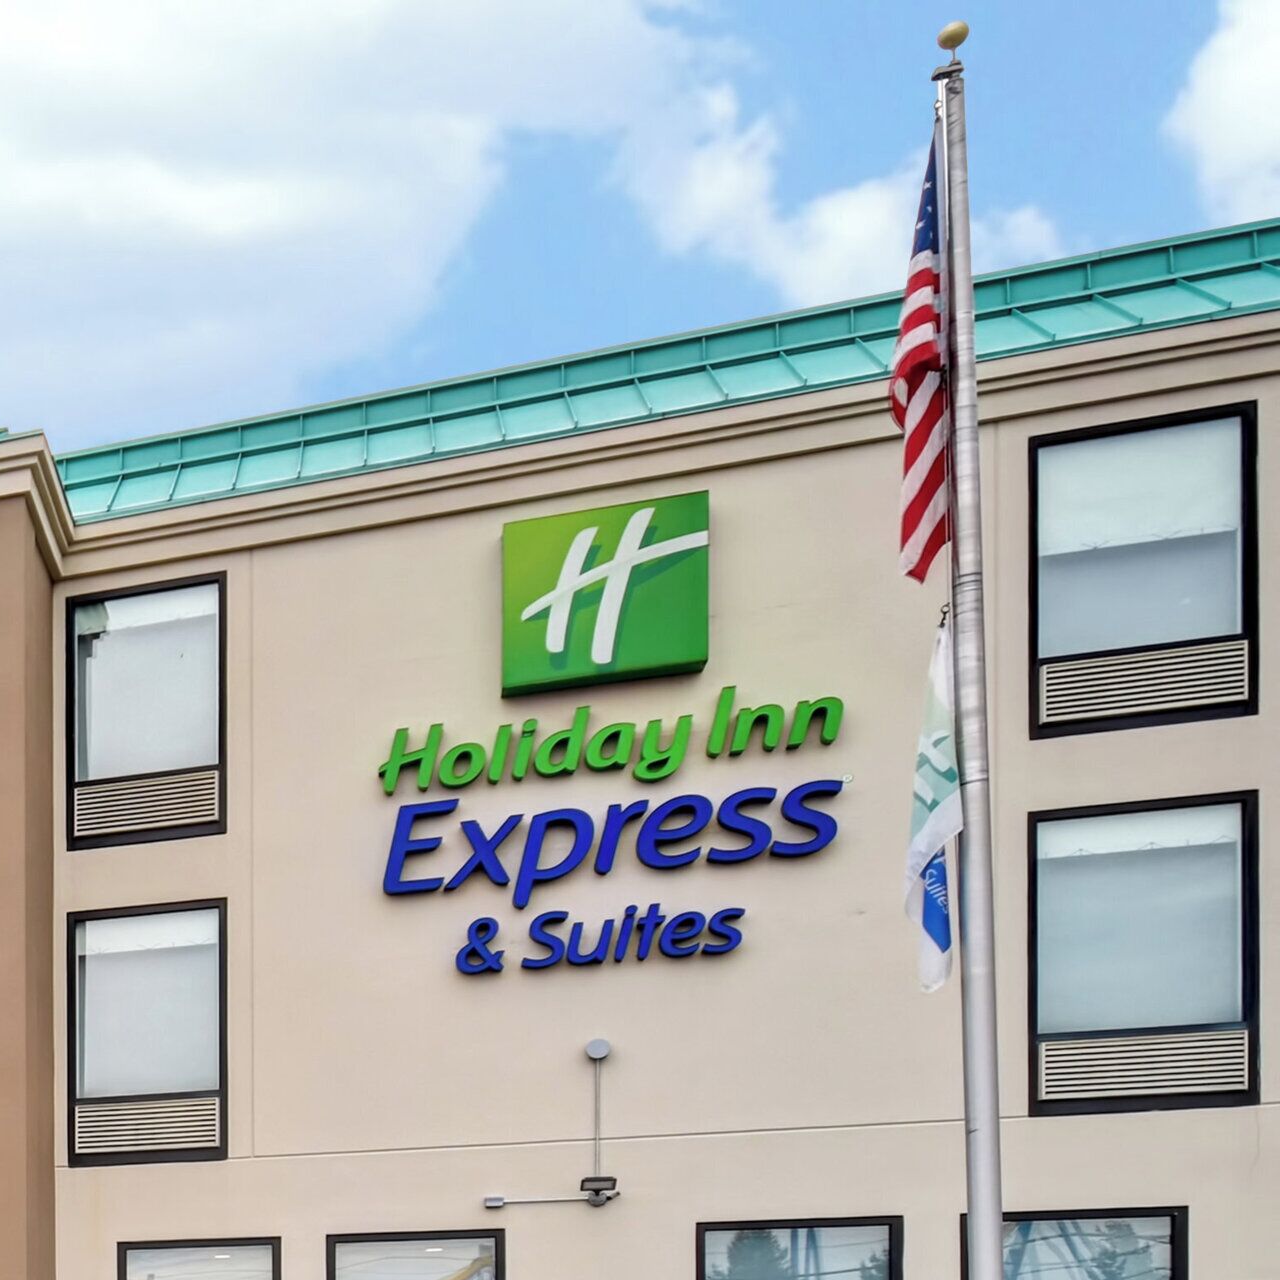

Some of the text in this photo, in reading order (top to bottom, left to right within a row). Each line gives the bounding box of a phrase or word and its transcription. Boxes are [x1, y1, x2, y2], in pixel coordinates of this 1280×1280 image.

[522, 508, 708, 664] H
[379, 686, 844, 794] Holiday Inn
[383, 779, 844, 909] Express
[455, 903, 745, 975] & Suites
